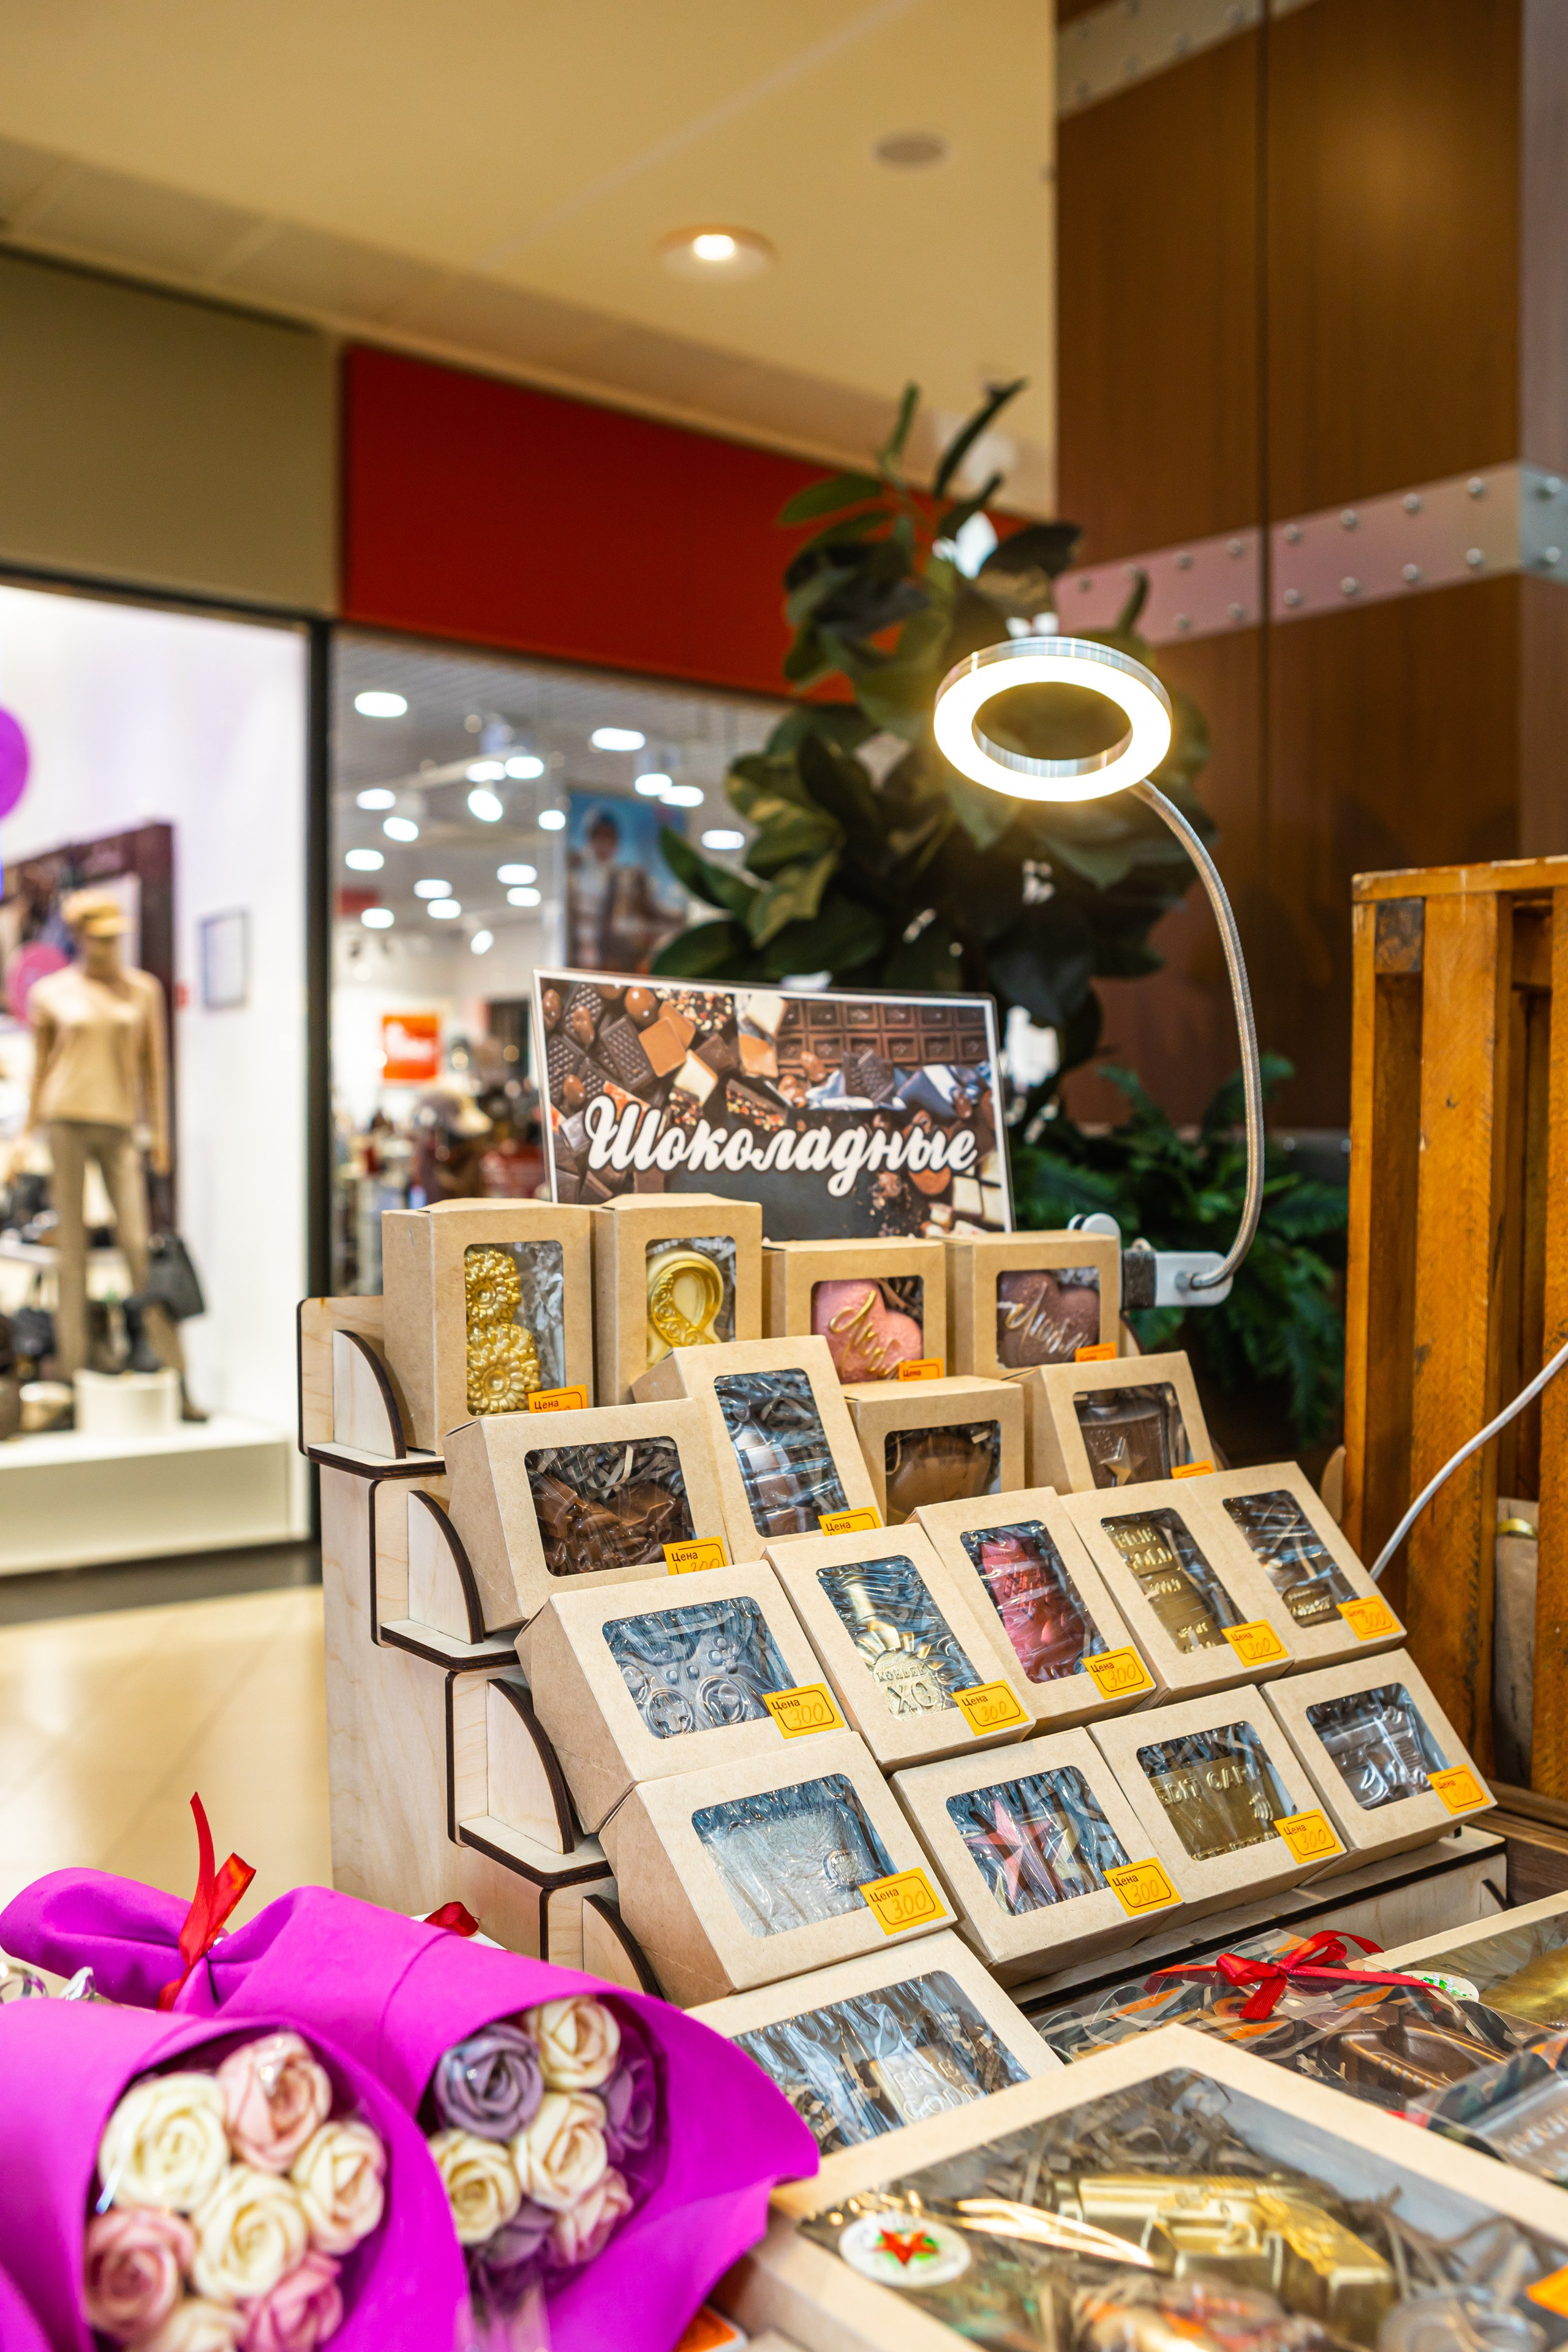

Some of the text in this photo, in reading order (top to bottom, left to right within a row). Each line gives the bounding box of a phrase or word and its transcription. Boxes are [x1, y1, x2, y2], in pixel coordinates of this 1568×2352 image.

[584, 1095, 978, 1197] Шоколадные
[534, 1400, 559, 1410] Цена
[826, 1521, 851, 1532] Цена
[671, 1552, 698, 1562] Цена
[1231, 1633, 1253, 1642] Цена
[1249, 1637, 1270, 1657] 300
[1090, 1662, 1115, 1673] Цена
[1108, 1664, 1136, 1688] 300
[771, 1699, 801, 1710] Цена
[961, 1695, 988, 1706] Цена
[790, 1703, 824, 1728] 300
[981, 1701, 1007, 1722] 300
[1283, 1825, 1306, 1835] Цена
[1301, 1829, 1326, 1850] 300
[1112, 1875, 1139, 1887] Цена
[869, 1888, 899, 1902] Цена
[1131, 1879, 1158, 1905] 300
[892, 1890, 926, 1920] 300
